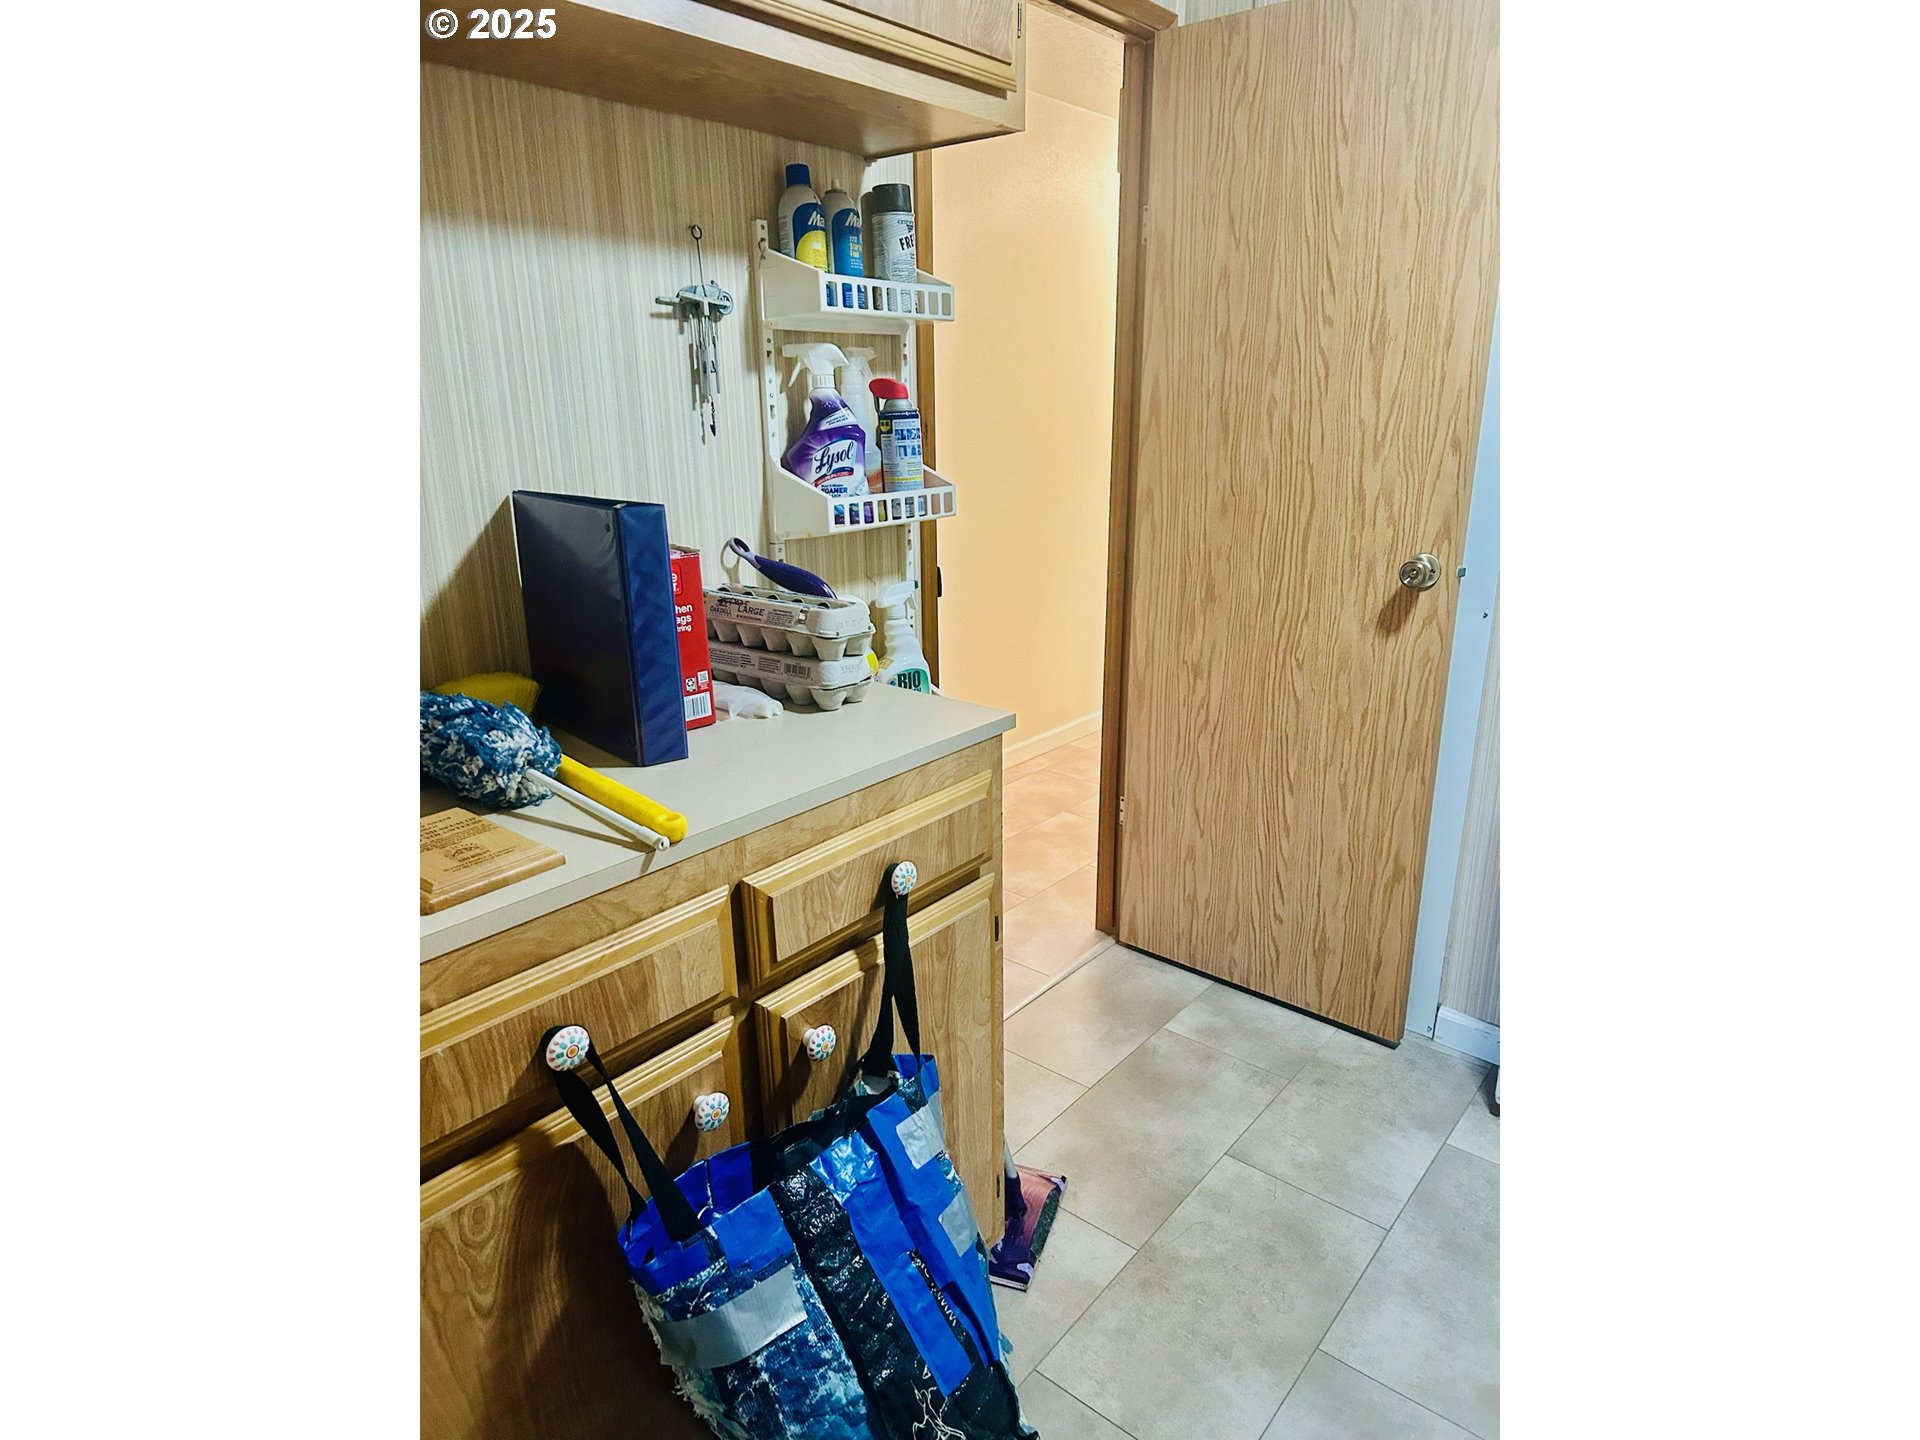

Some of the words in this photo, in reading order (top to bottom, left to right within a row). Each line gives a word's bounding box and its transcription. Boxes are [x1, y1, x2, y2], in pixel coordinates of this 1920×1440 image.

[807, 210, 825, 227] Ma
[899, 234, 915, 251] FRE
[814, 441, 854, 474] Lysol
[674, 604, 693, 614] hen
[737, 605, 765, 617] LARGE
[675, 614, 692, 625] ags
